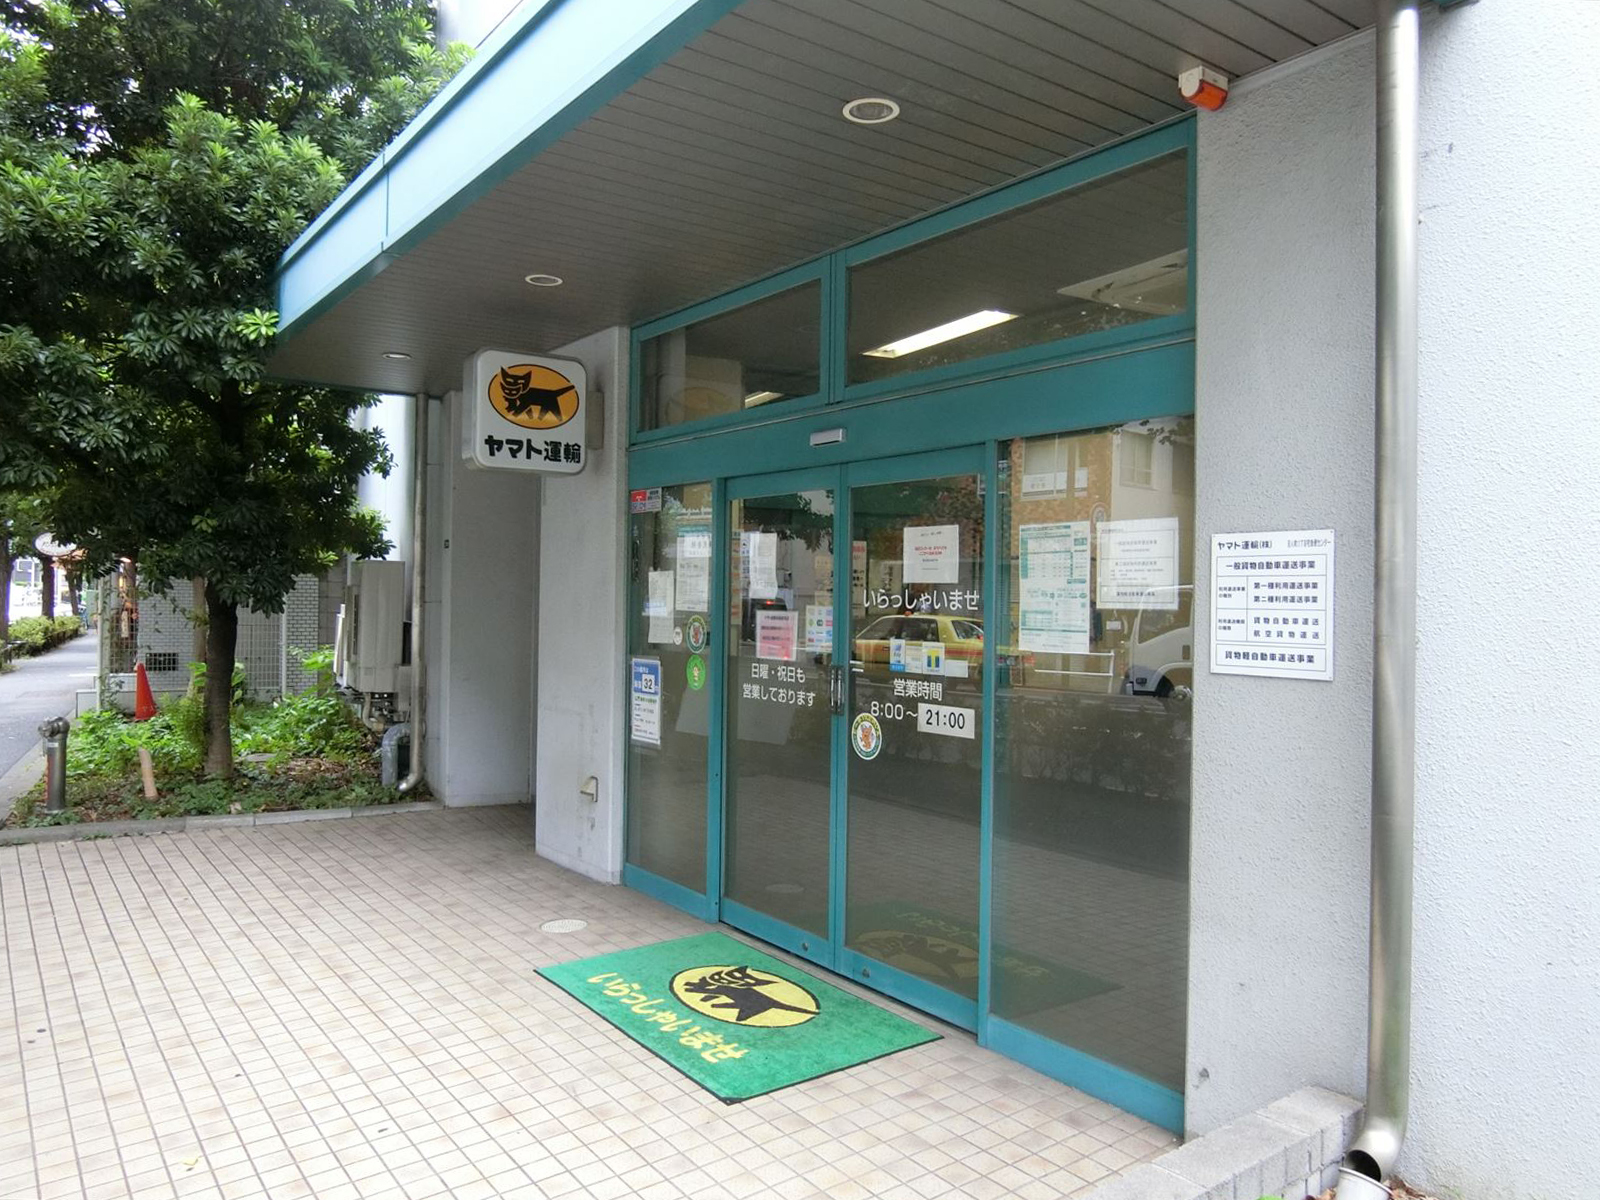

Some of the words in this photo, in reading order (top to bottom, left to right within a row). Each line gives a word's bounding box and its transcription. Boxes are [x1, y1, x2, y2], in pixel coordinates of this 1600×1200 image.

[484, 435, 581, 464] ヤマト運輸
[1226, 560, 1316, 571] 一般貨物自動車運送事業
[1253, 582, 1318, 590] 第一種利用運送事業
[863, 588, 980, 611] いらっしゃいませ
[1253, 596, 1318, 604] 第二種利用運送事業
[1225, 650, 1315, 664] 貨物軽自動車運送事業
[751, 663, 806, 683] 日曜・祝日も
[643, 678, 653, 690] 32
[893, 678, 943, 701] 営業時間
[742, 683, 816, 707] 営業しております
[586, 971, 750, 1065] いらっしゃいませ
